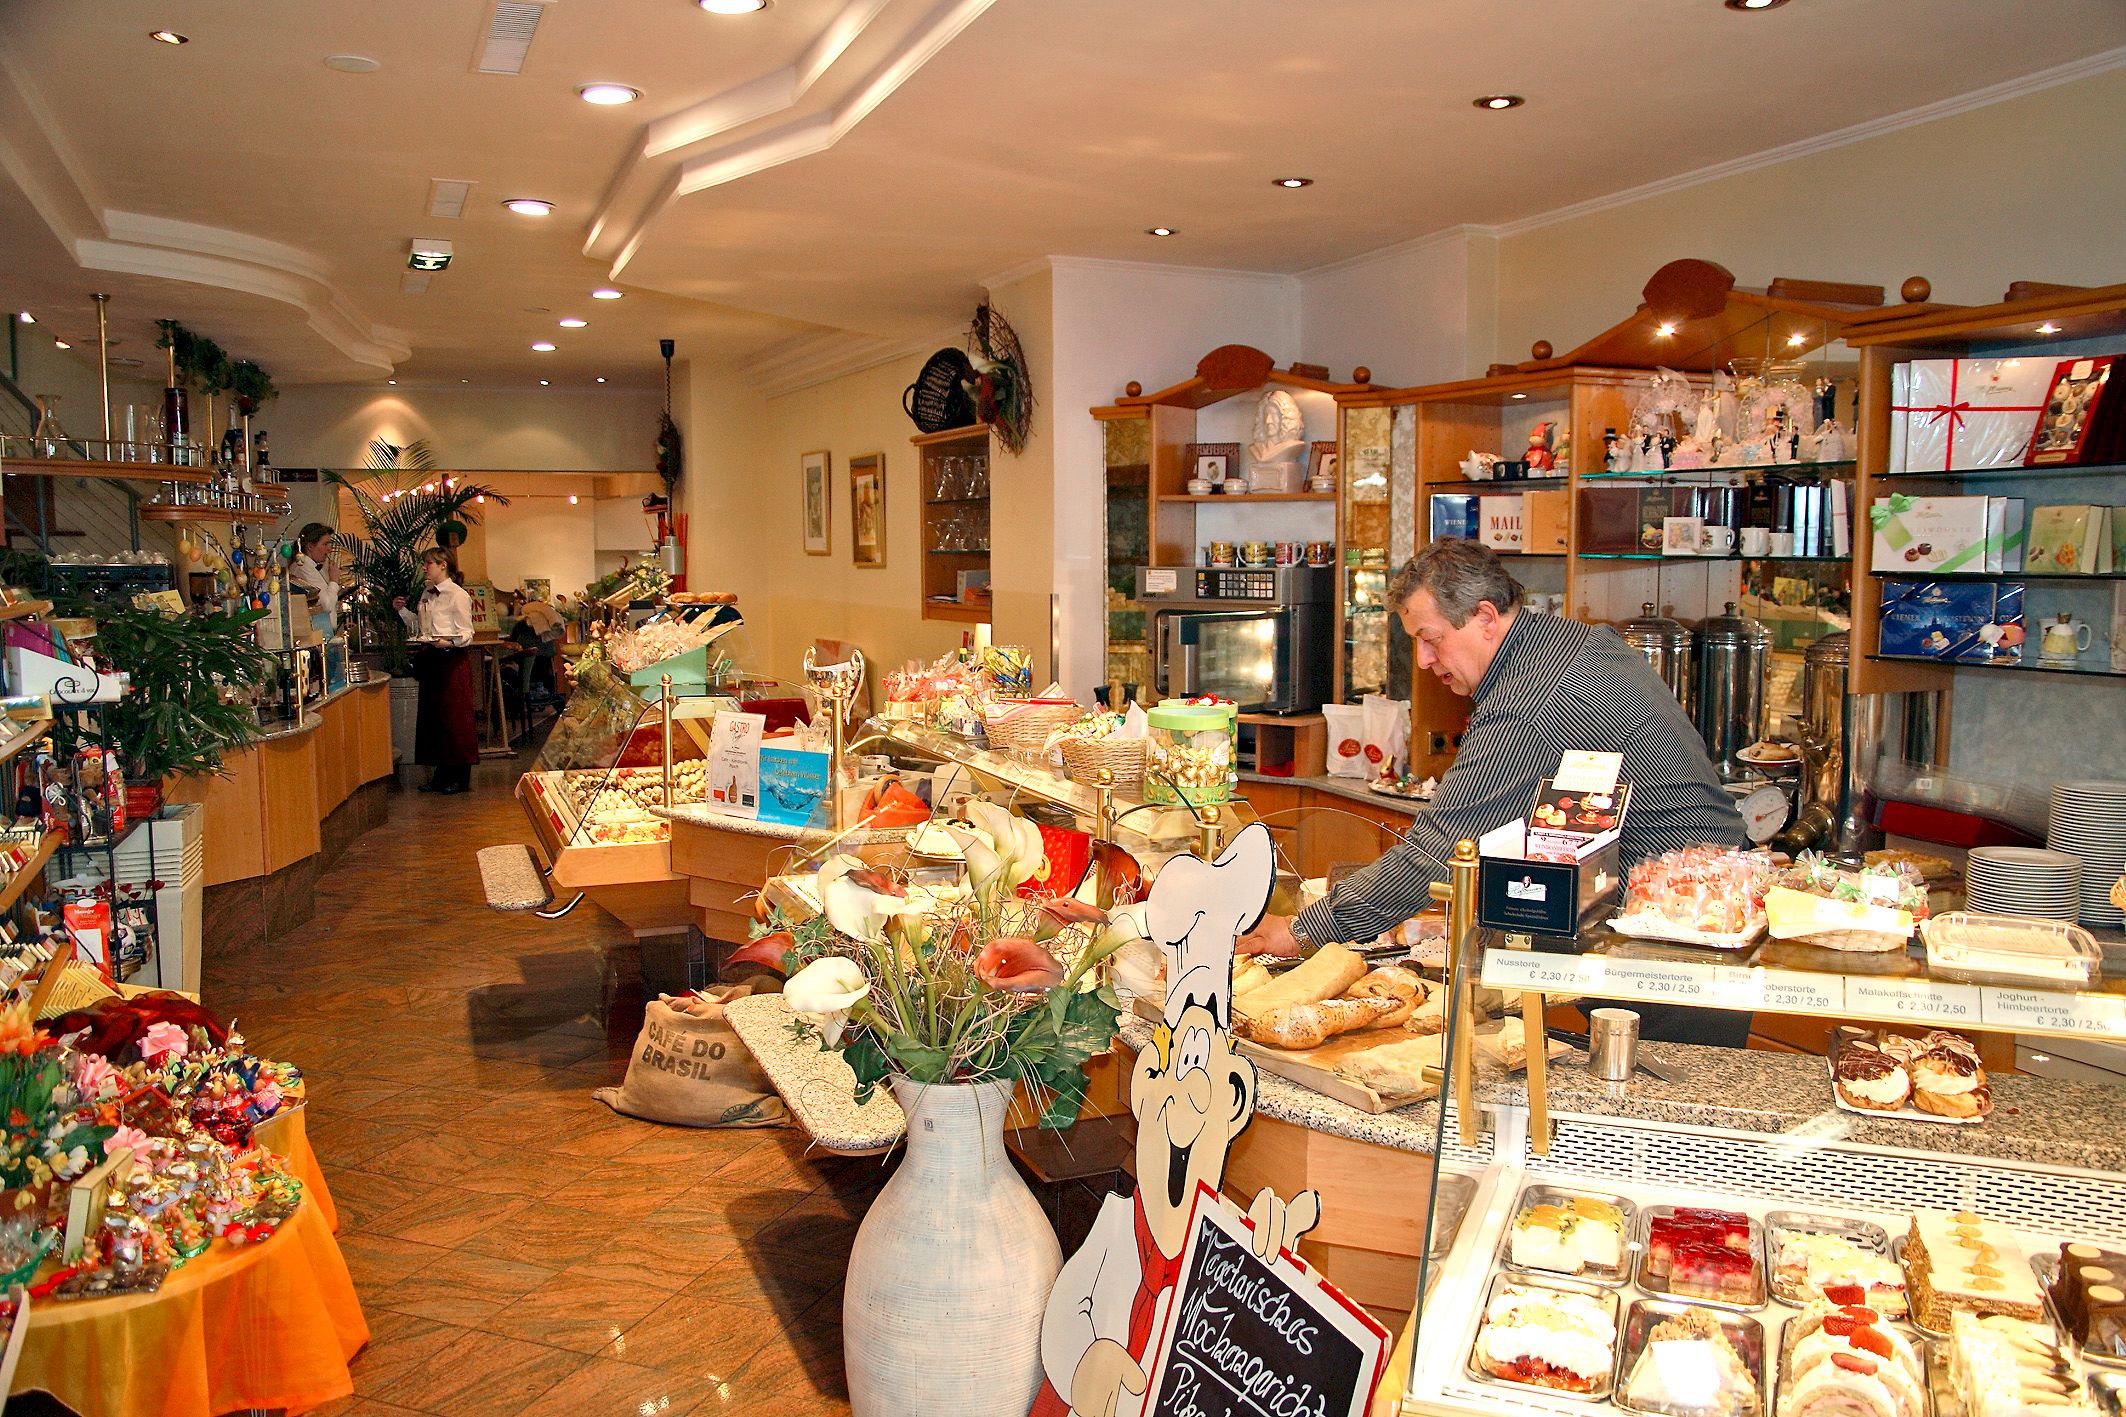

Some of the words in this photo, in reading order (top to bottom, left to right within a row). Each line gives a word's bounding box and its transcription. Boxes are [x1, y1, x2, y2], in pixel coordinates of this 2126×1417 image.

[1496, 958, 1540, 969] Nusstorte
[1529, 970, 1536, 979] €
[1541, 971, 1561, 981] 2,30
[1637, 980, 1644, 989] €
[1649, 981, 1670, 992] 2,30
[1678, 984, 1700, 994] 2,50
[1775, 994, 1798, 1005] 2,30
[1806, 996, 1829, 1007] 2,50
[1996, 992, 2038, 1002] Joghurt
[1897, 1000, 1904, 1010] €
[1942, 1004, 1967, 1015] 2,50
[1997, 1001, 2069, 1015] Himbeertorte
[2037, 1015, 2044, 1025] €
[2051, 1017, 2076, 1028] 2,30
[648, 1020, 688, 1054] CAFÉ
[691, 1038, 727, 1061] DO
[641, 1043, 712, 1081] BRASIL
[1198, 1220, 1319, 1356] Vegetarisches
